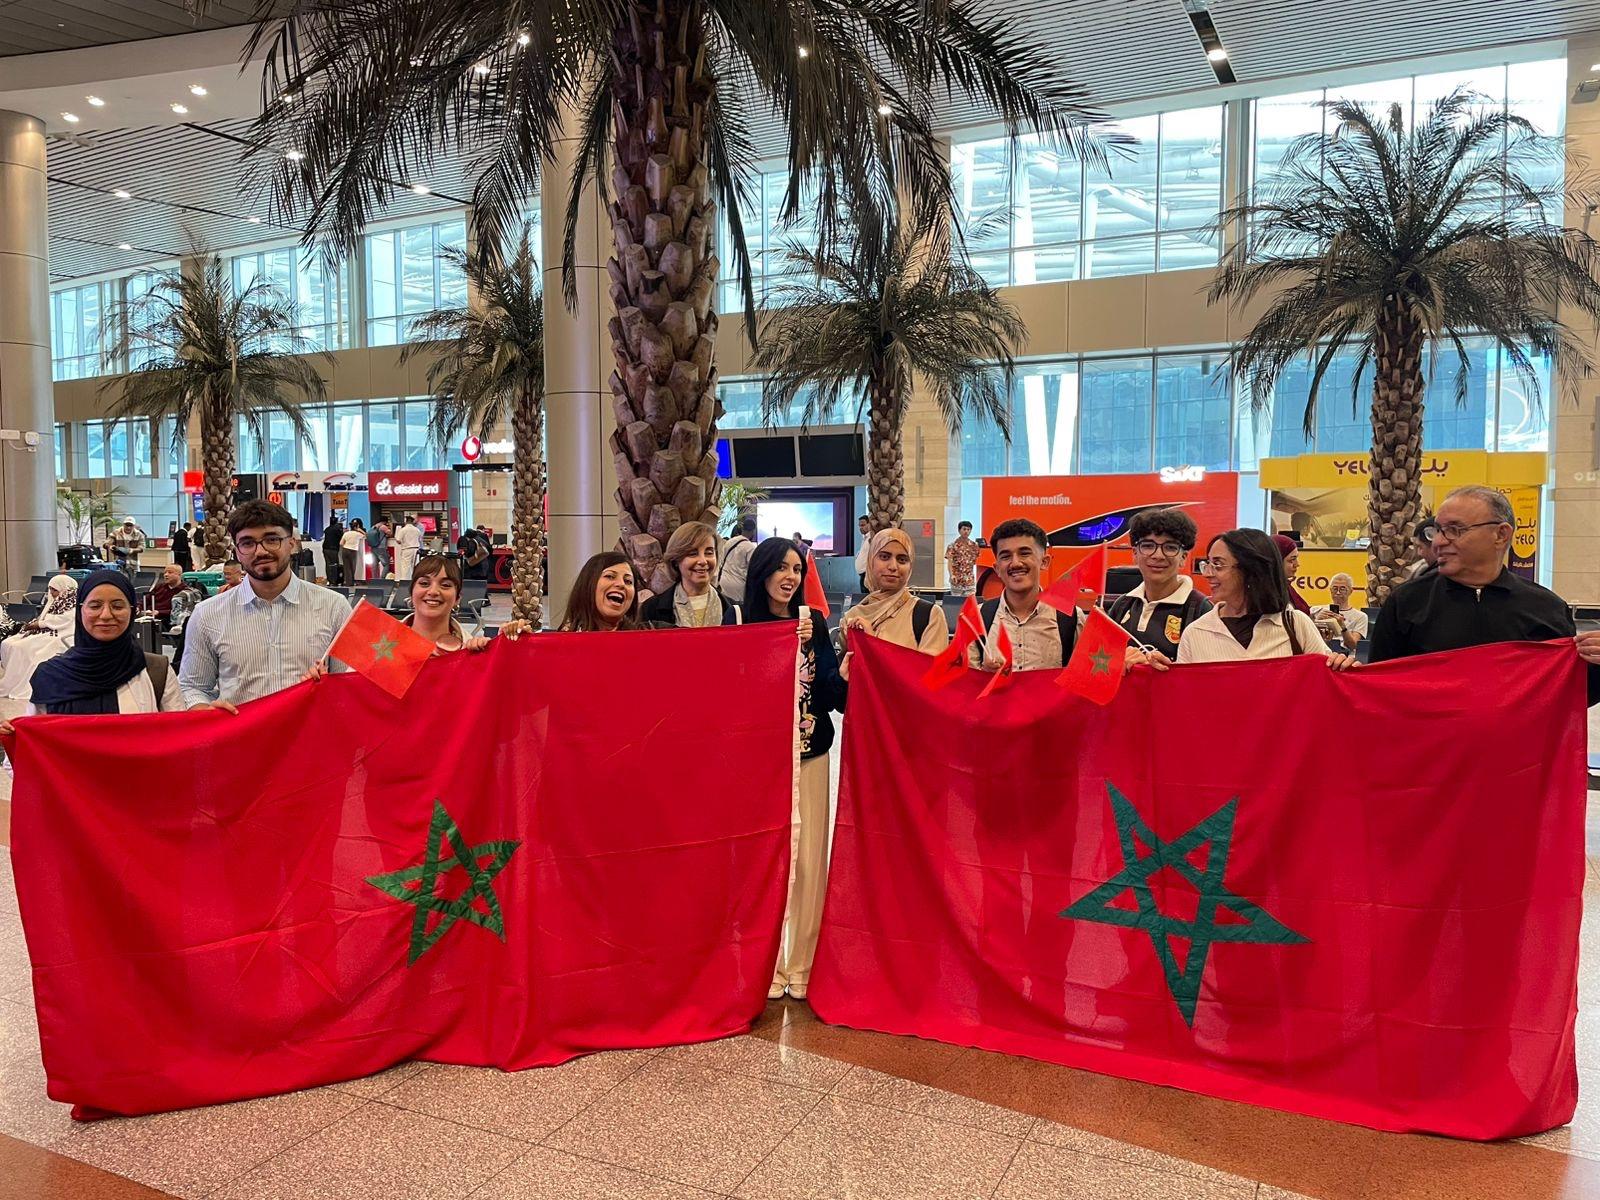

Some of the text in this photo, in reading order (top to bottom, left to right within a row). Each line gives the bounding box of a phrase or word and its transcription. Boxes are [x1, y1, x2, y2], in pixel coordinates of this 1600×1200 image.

[1333, 460, 1369, 474] YEL
[1421, 458, 1449, 477] يل
[423, 483, 439, 495] and
[1009, 495, 1025, 505] feel
[1026, 495, 1039, 505] the
[1515, 533, 1535, 545] YELO
